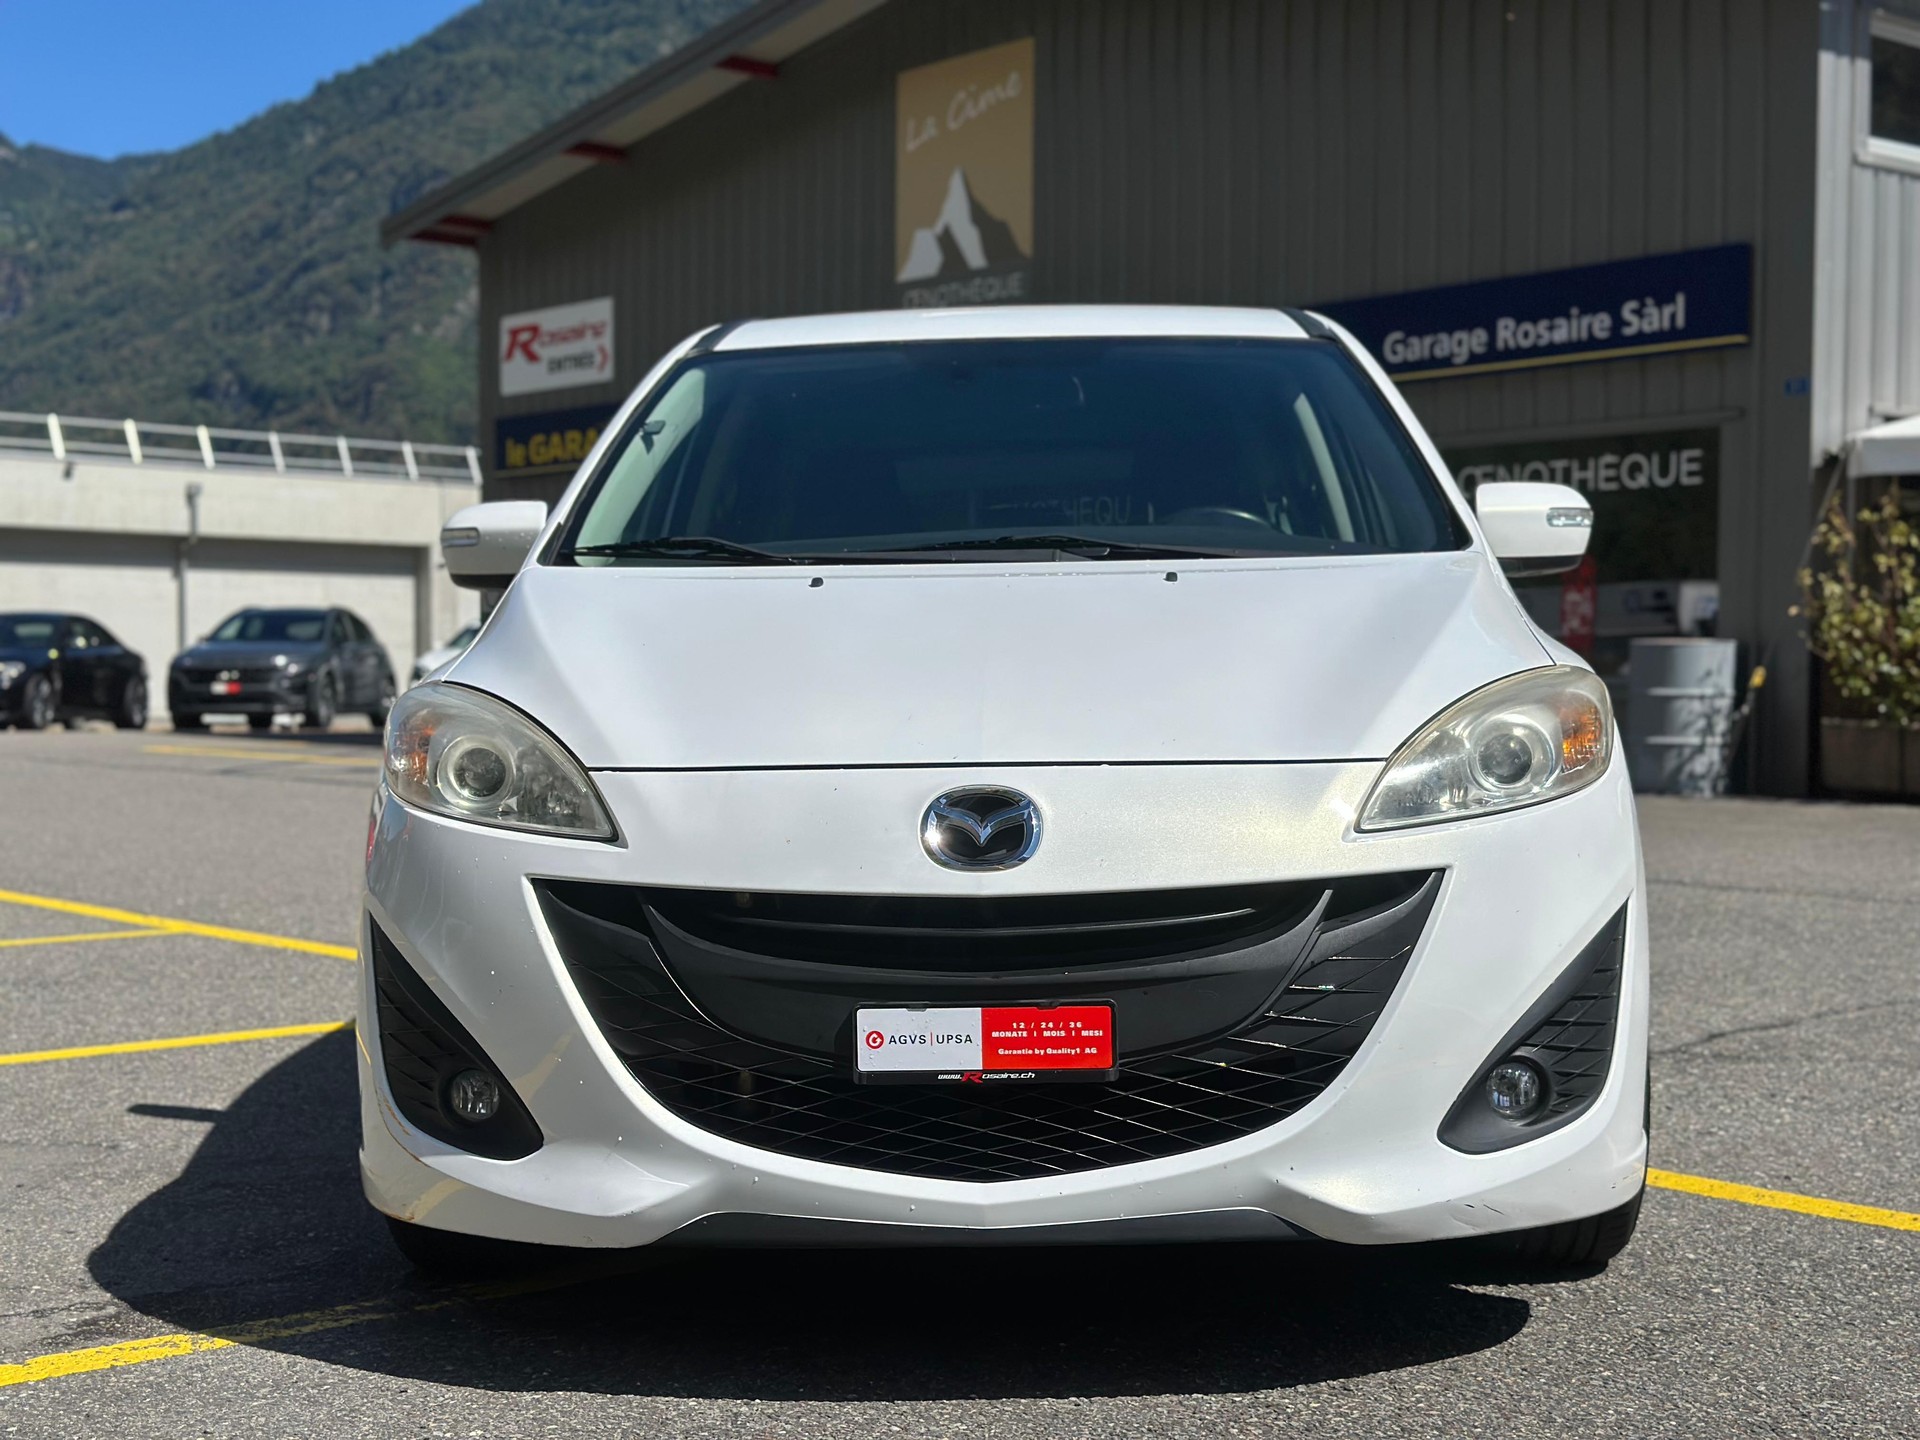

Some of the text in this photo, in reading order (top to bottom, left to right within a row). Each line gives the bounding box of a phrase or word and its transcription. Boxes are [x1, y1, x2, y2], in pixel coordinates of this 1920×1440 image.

[906, 116, 939, 152] La
[1382, 292, 1686, 365] Garage Rosaire Sàrl
[505, 437, 527, 468] le
[1040, 1021, 1054, 1029] 24
[888, 1034, 927, 1045] AGVS
[936, 1034, 973, 1044] UPSA
[1034, 1048, 1045, 1056] by
[1046, 1047, 1080, 1056] Quality1
[937, 1072, 1036, 1084] www.Rosaire.ch
